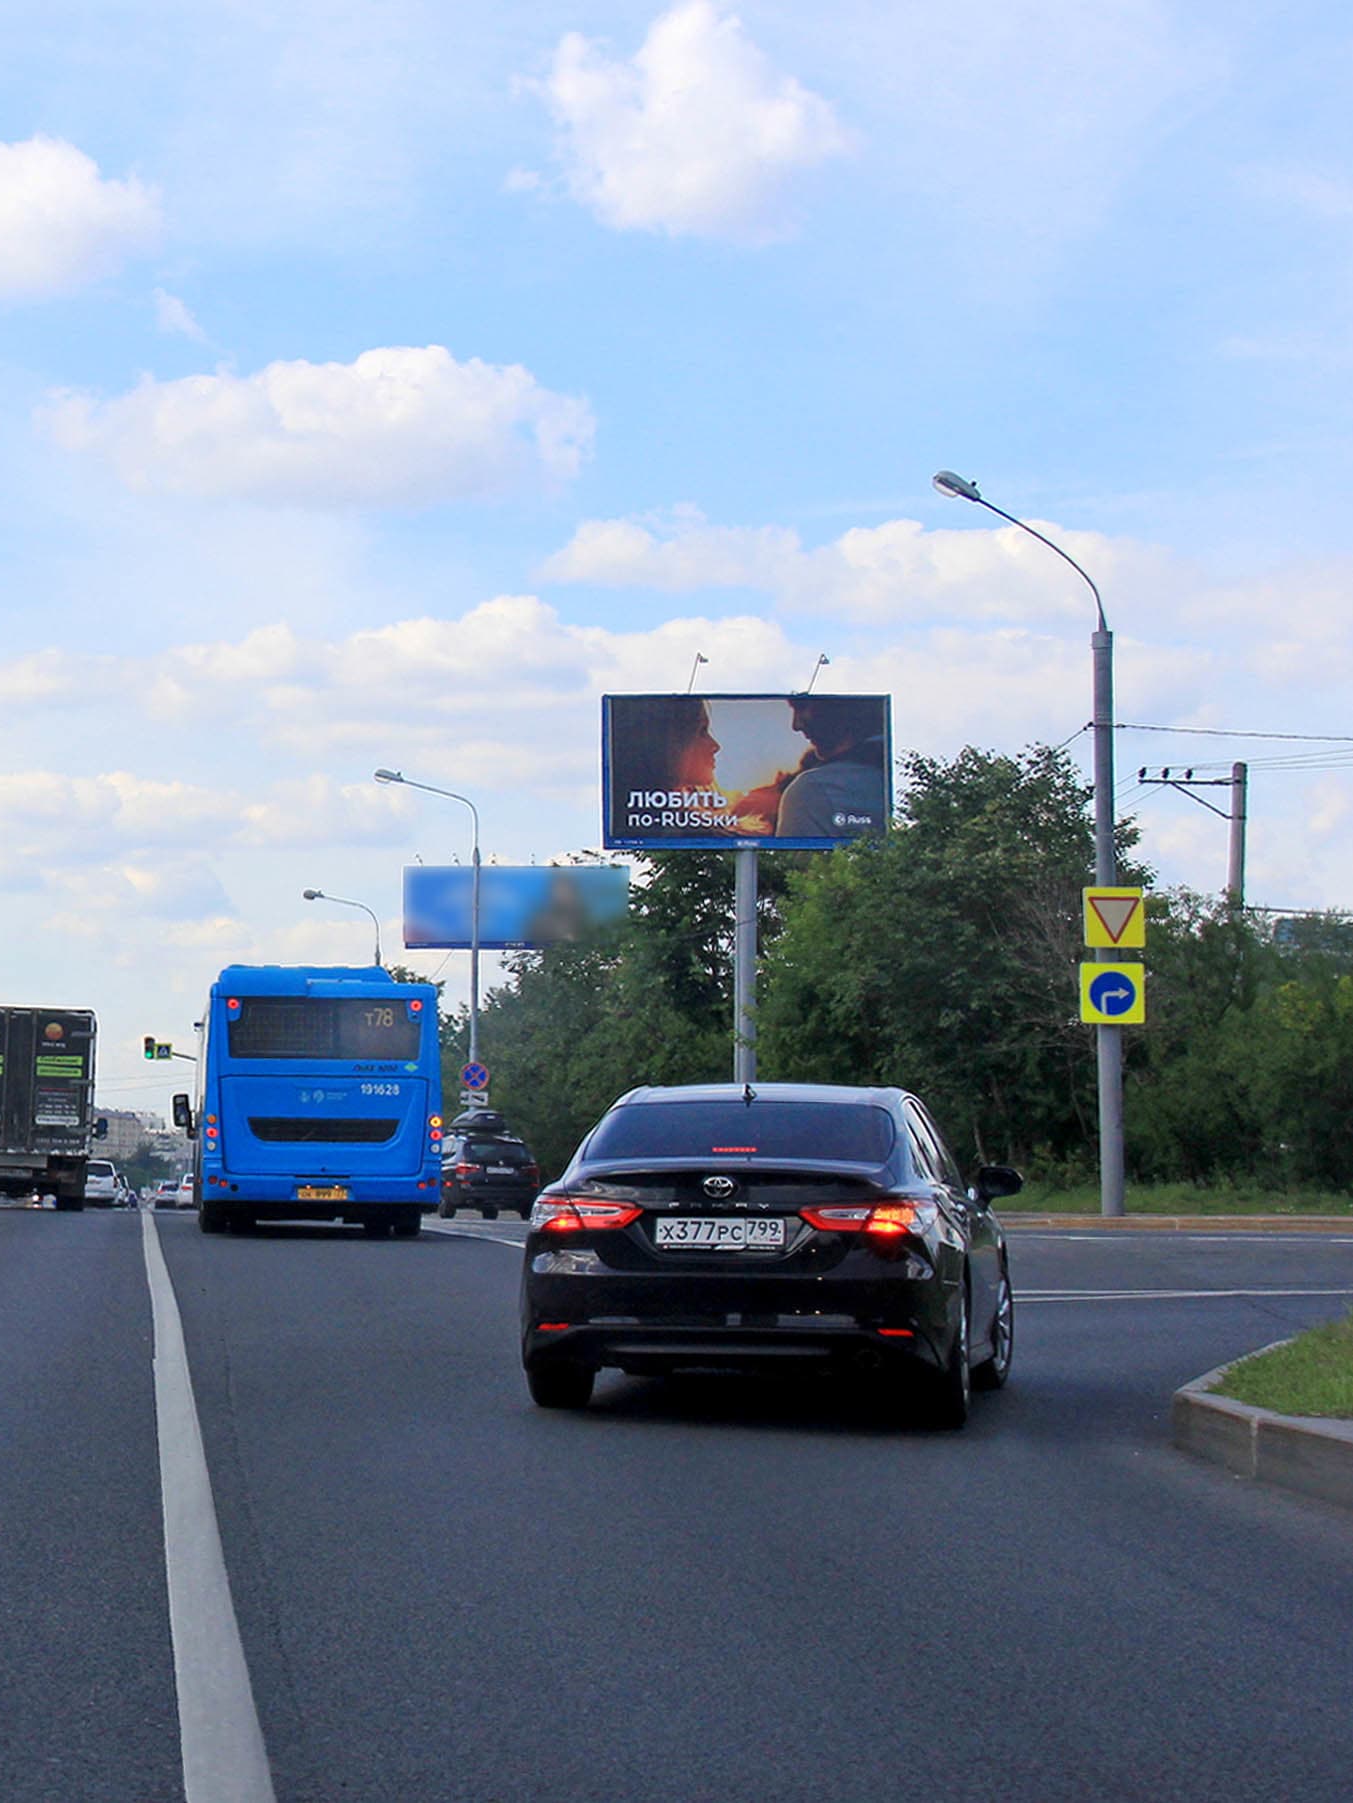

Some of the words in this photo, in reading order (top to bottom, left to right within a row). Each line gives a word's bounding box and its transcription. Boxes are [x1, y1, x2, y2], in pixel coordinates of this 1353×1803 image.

[627, 791, 728, 808] ЛЮБИТЬ
[628, 811, 738, 827] по-RUSSки
[360, 1083, 400, 1096] 191628
[747, 1220, 779, 1236] 799
